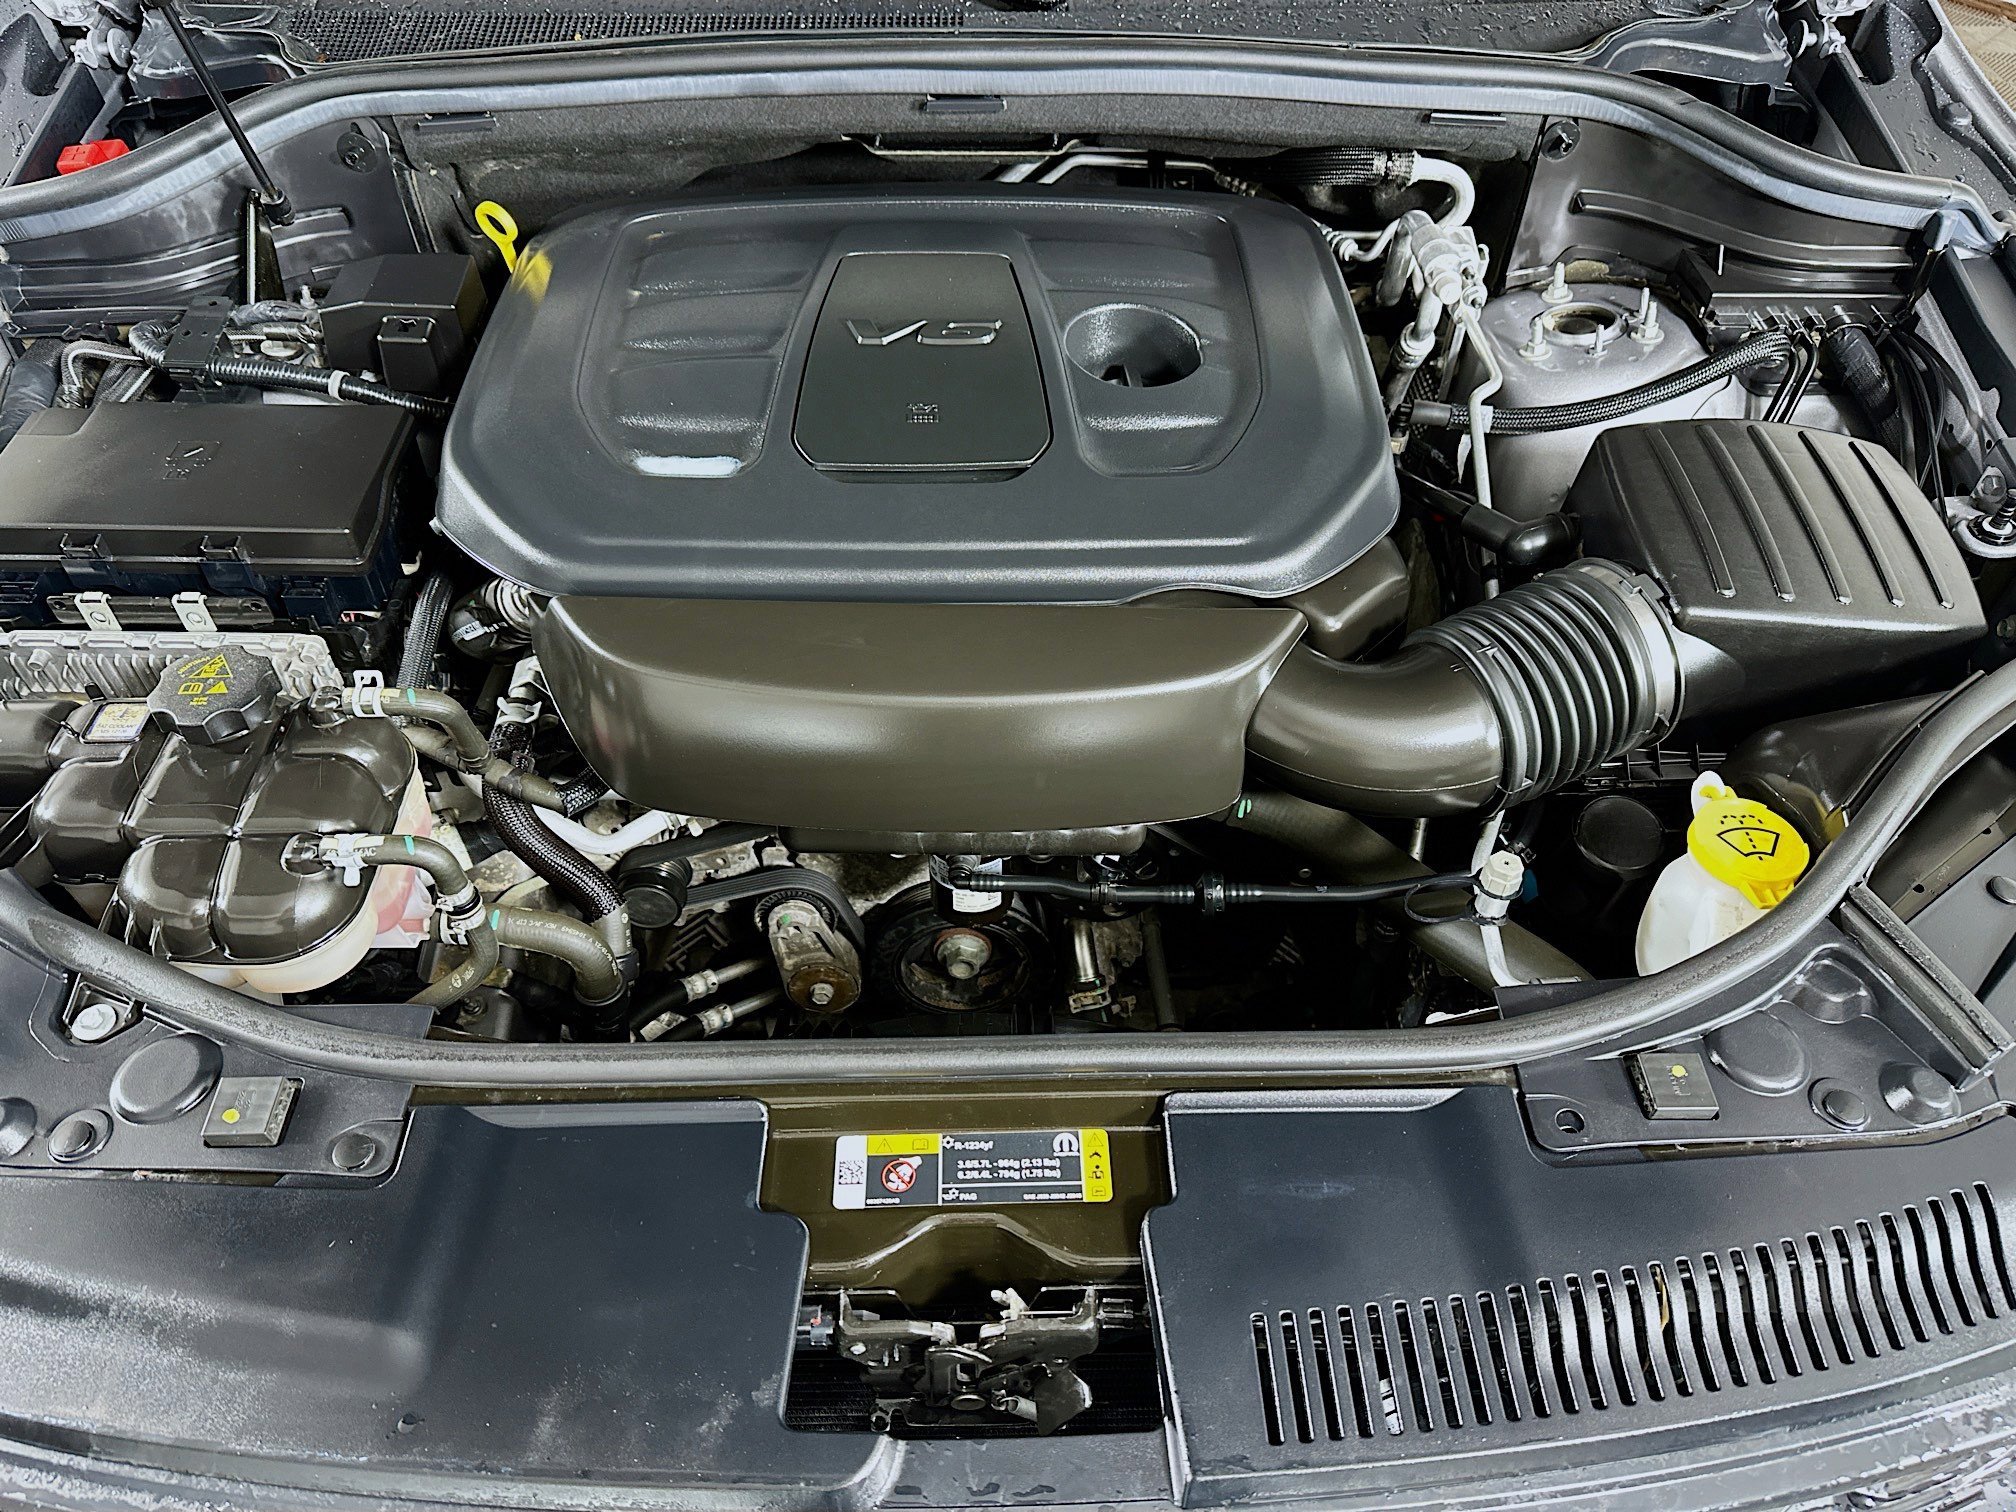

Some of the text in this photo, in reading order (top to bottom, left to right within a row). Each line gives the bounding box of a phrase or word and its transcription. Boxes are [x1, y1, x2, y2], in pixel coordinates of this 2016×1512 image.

[846, 319, 1003, 346] V6
[954, 1140, 994, 1152] R-1234yf
[957, 1159, 993, 1169] 3.6/5.7L
[1021, 1158, 1043, 1168] (2.13
[1043, 1157, 1061, 1168] lbs)
[1021, 1169, 1043, 1179] (1.75
[1043, 1168, 1062, 1178] lbs)
